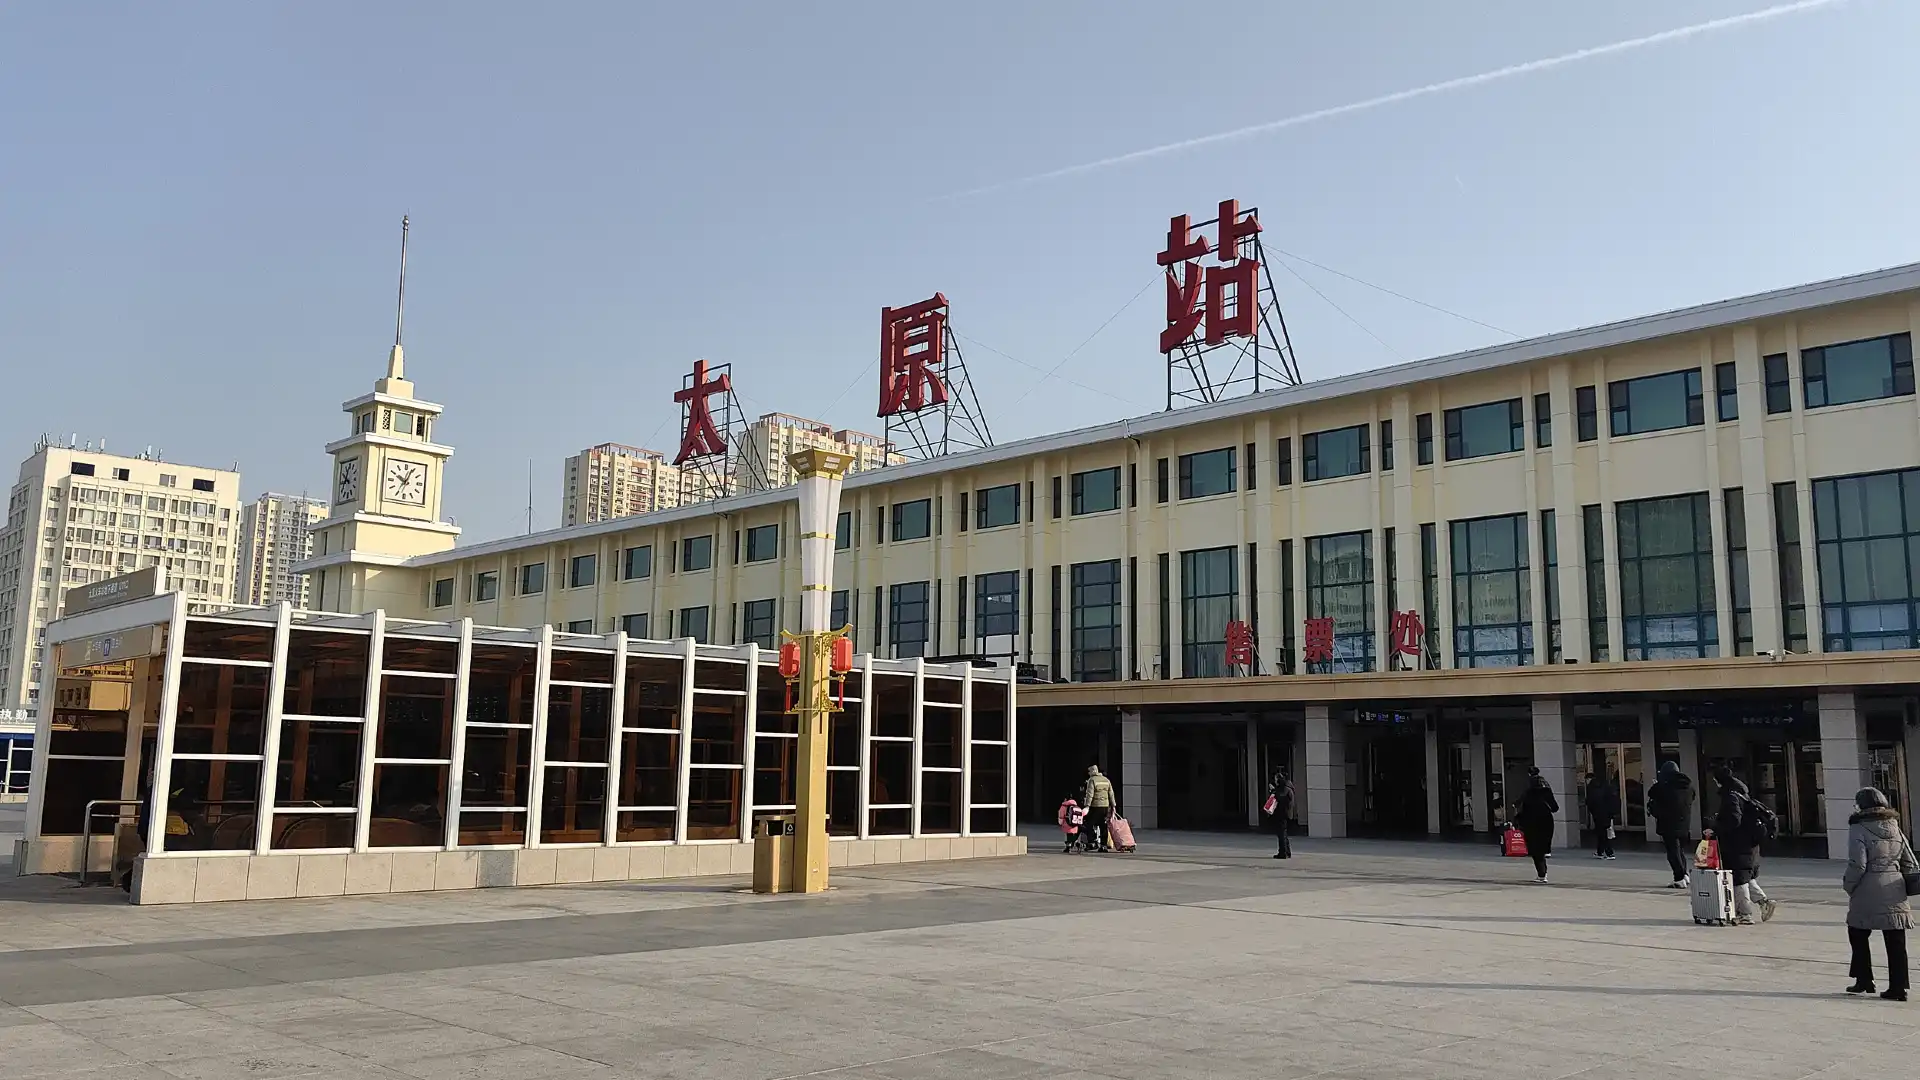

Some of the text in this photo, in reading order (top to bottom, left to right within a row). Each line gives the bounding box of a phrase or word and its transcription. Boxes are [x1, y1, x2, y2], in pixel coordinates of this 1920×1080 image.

[673, 199, 1263, 466] 太原站
[1224, 609, 1424, 666] 售票处
